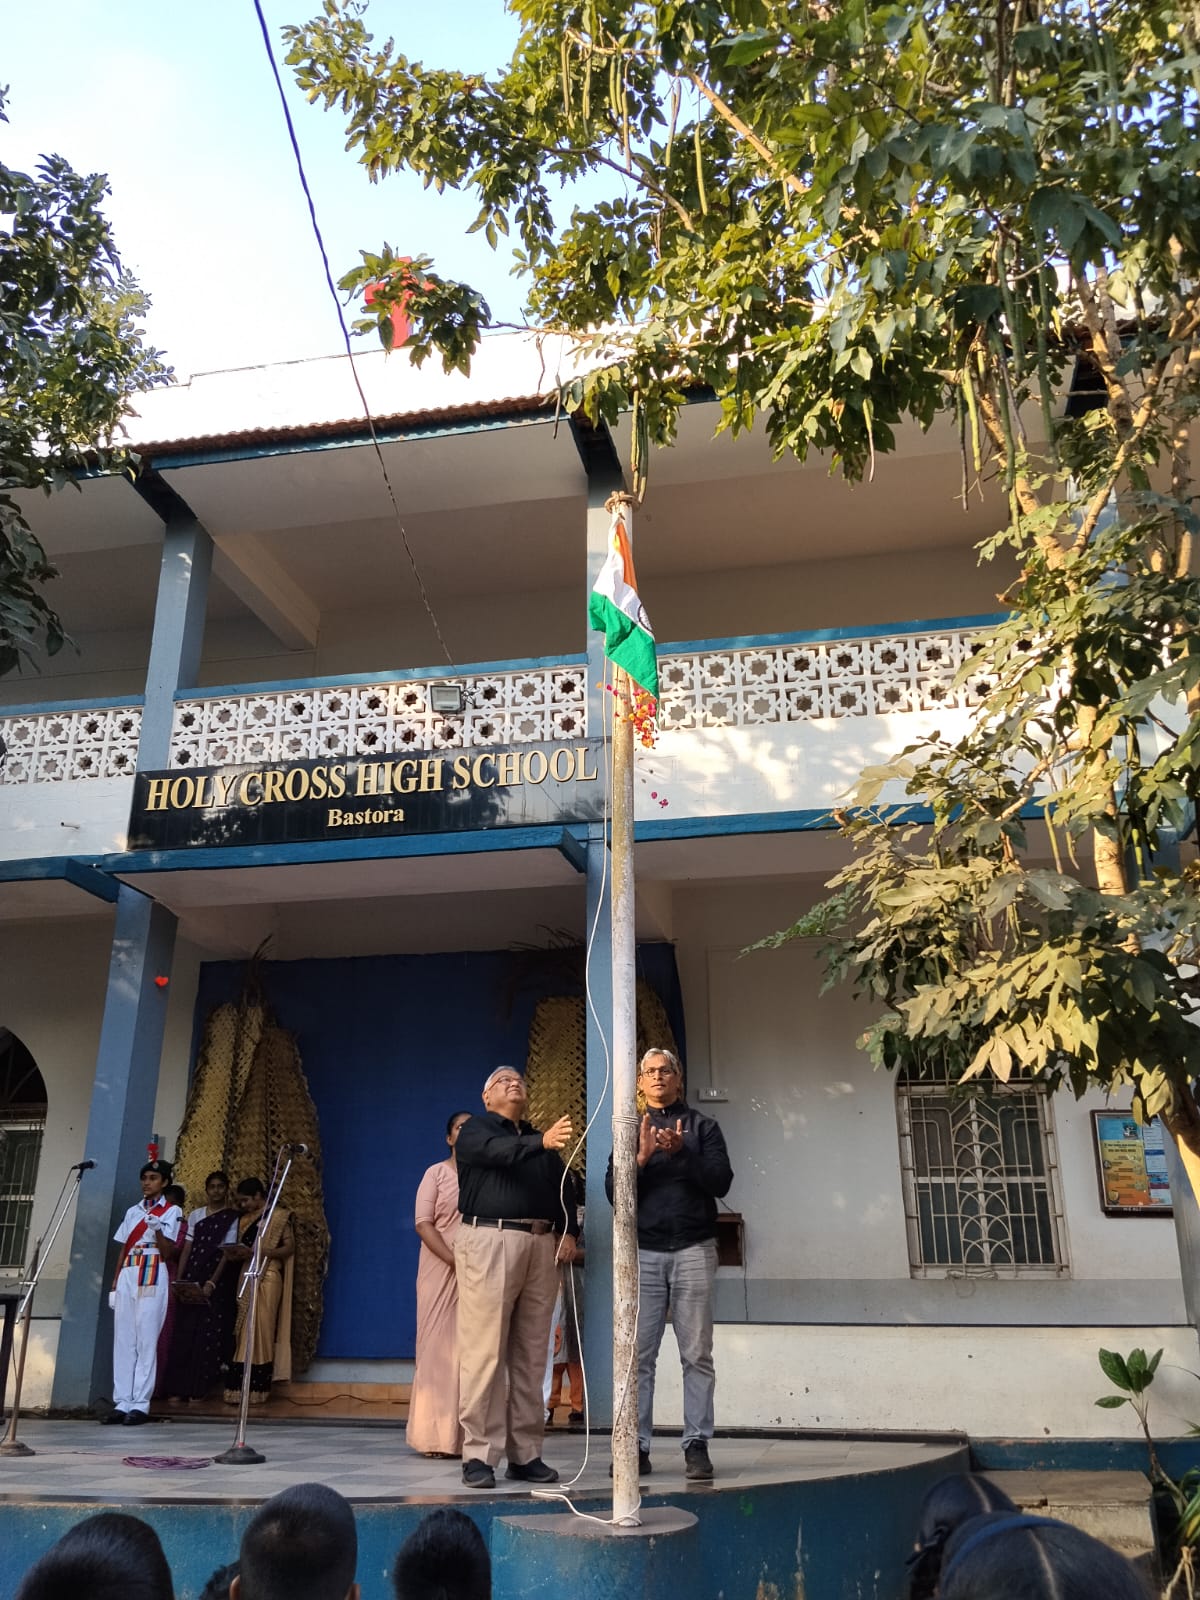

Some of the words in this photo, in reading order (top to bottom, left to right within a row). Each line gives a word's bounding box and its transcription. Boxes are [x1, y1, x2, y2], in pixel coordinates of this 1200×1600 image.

[144, 772, 238, 811] HOLY
[240, 764, 346, 806] CROSS
[355, 758, 444, 796] HIGH
[452, 747, 598, 789] SCHOOL
[327, 807, 404, 827] Bastora
